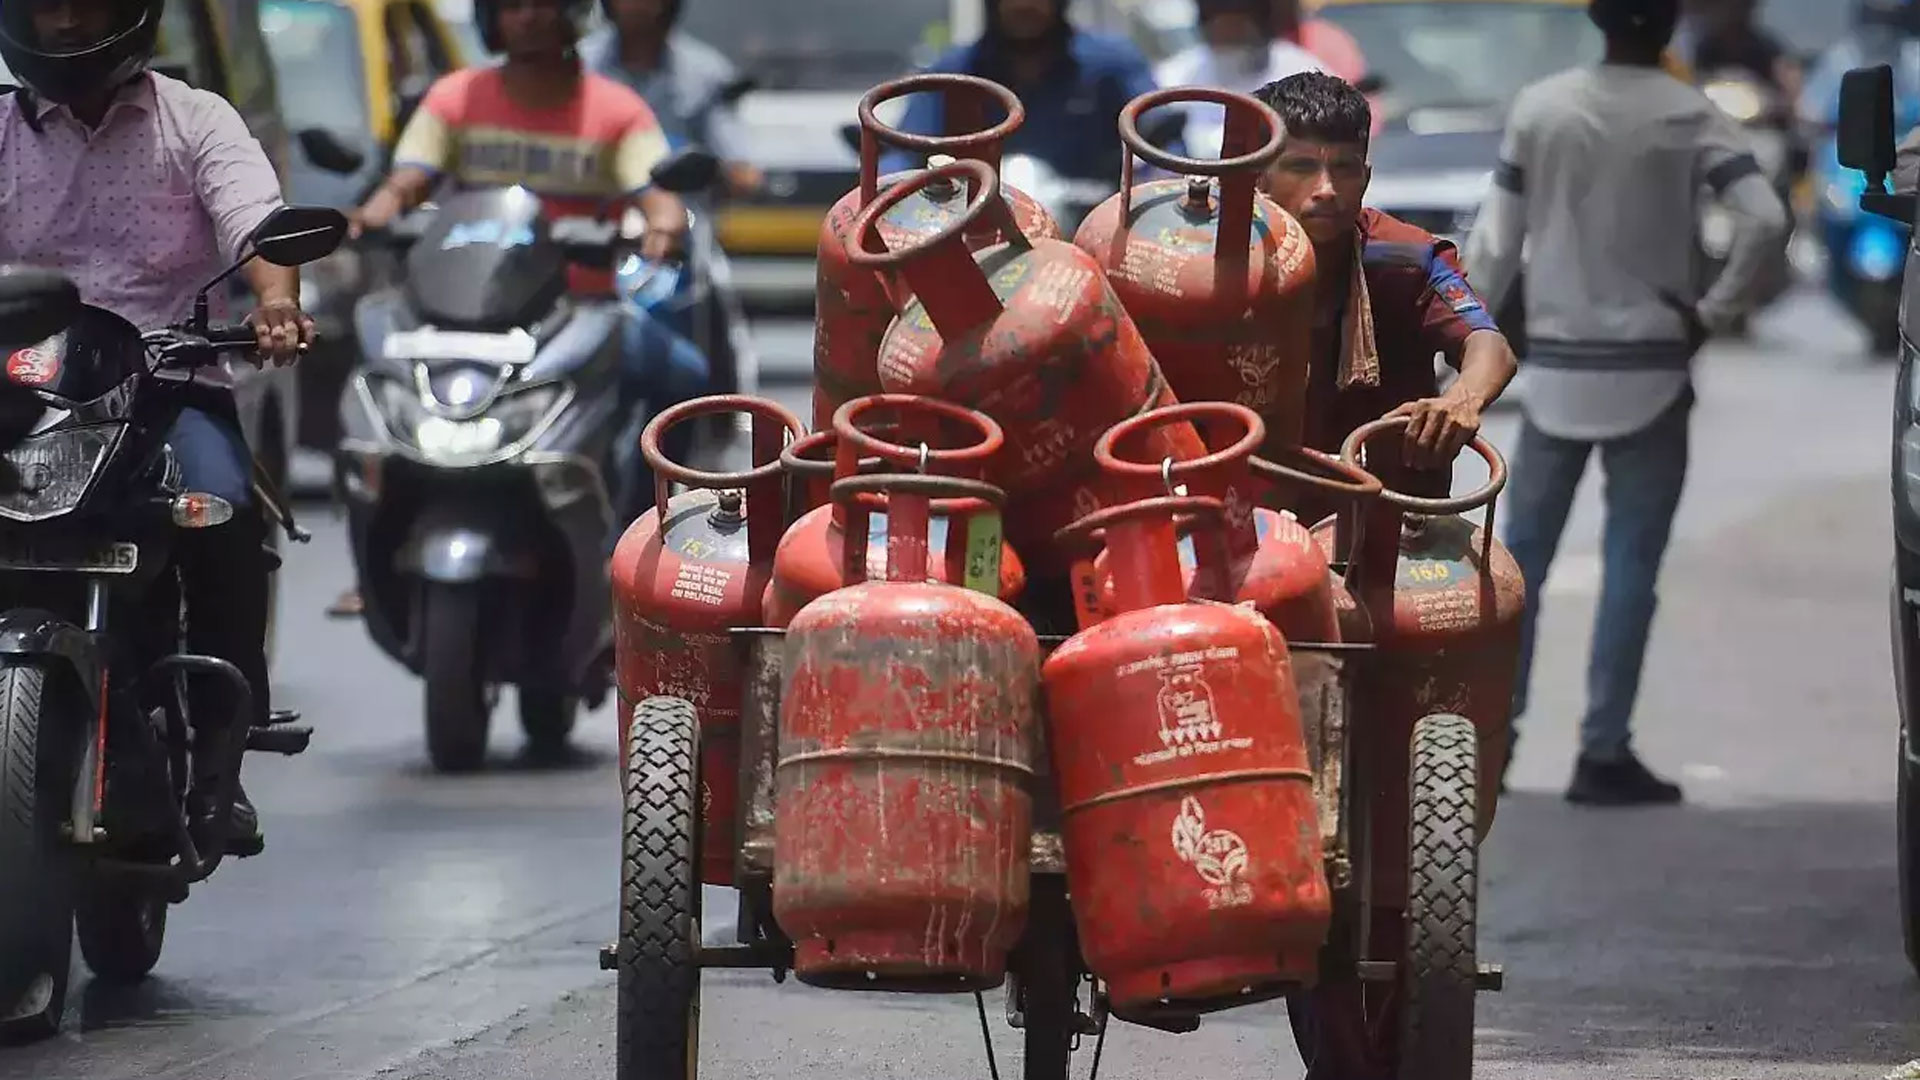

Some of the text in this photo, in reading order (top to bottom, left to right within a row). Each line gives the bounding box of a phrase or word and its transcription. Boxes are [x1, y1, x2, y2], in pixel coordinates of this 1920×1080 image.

[671, 588, 724, 606] ON DELIVERY
[675, 580, 724, 597] CHECK SEAL
